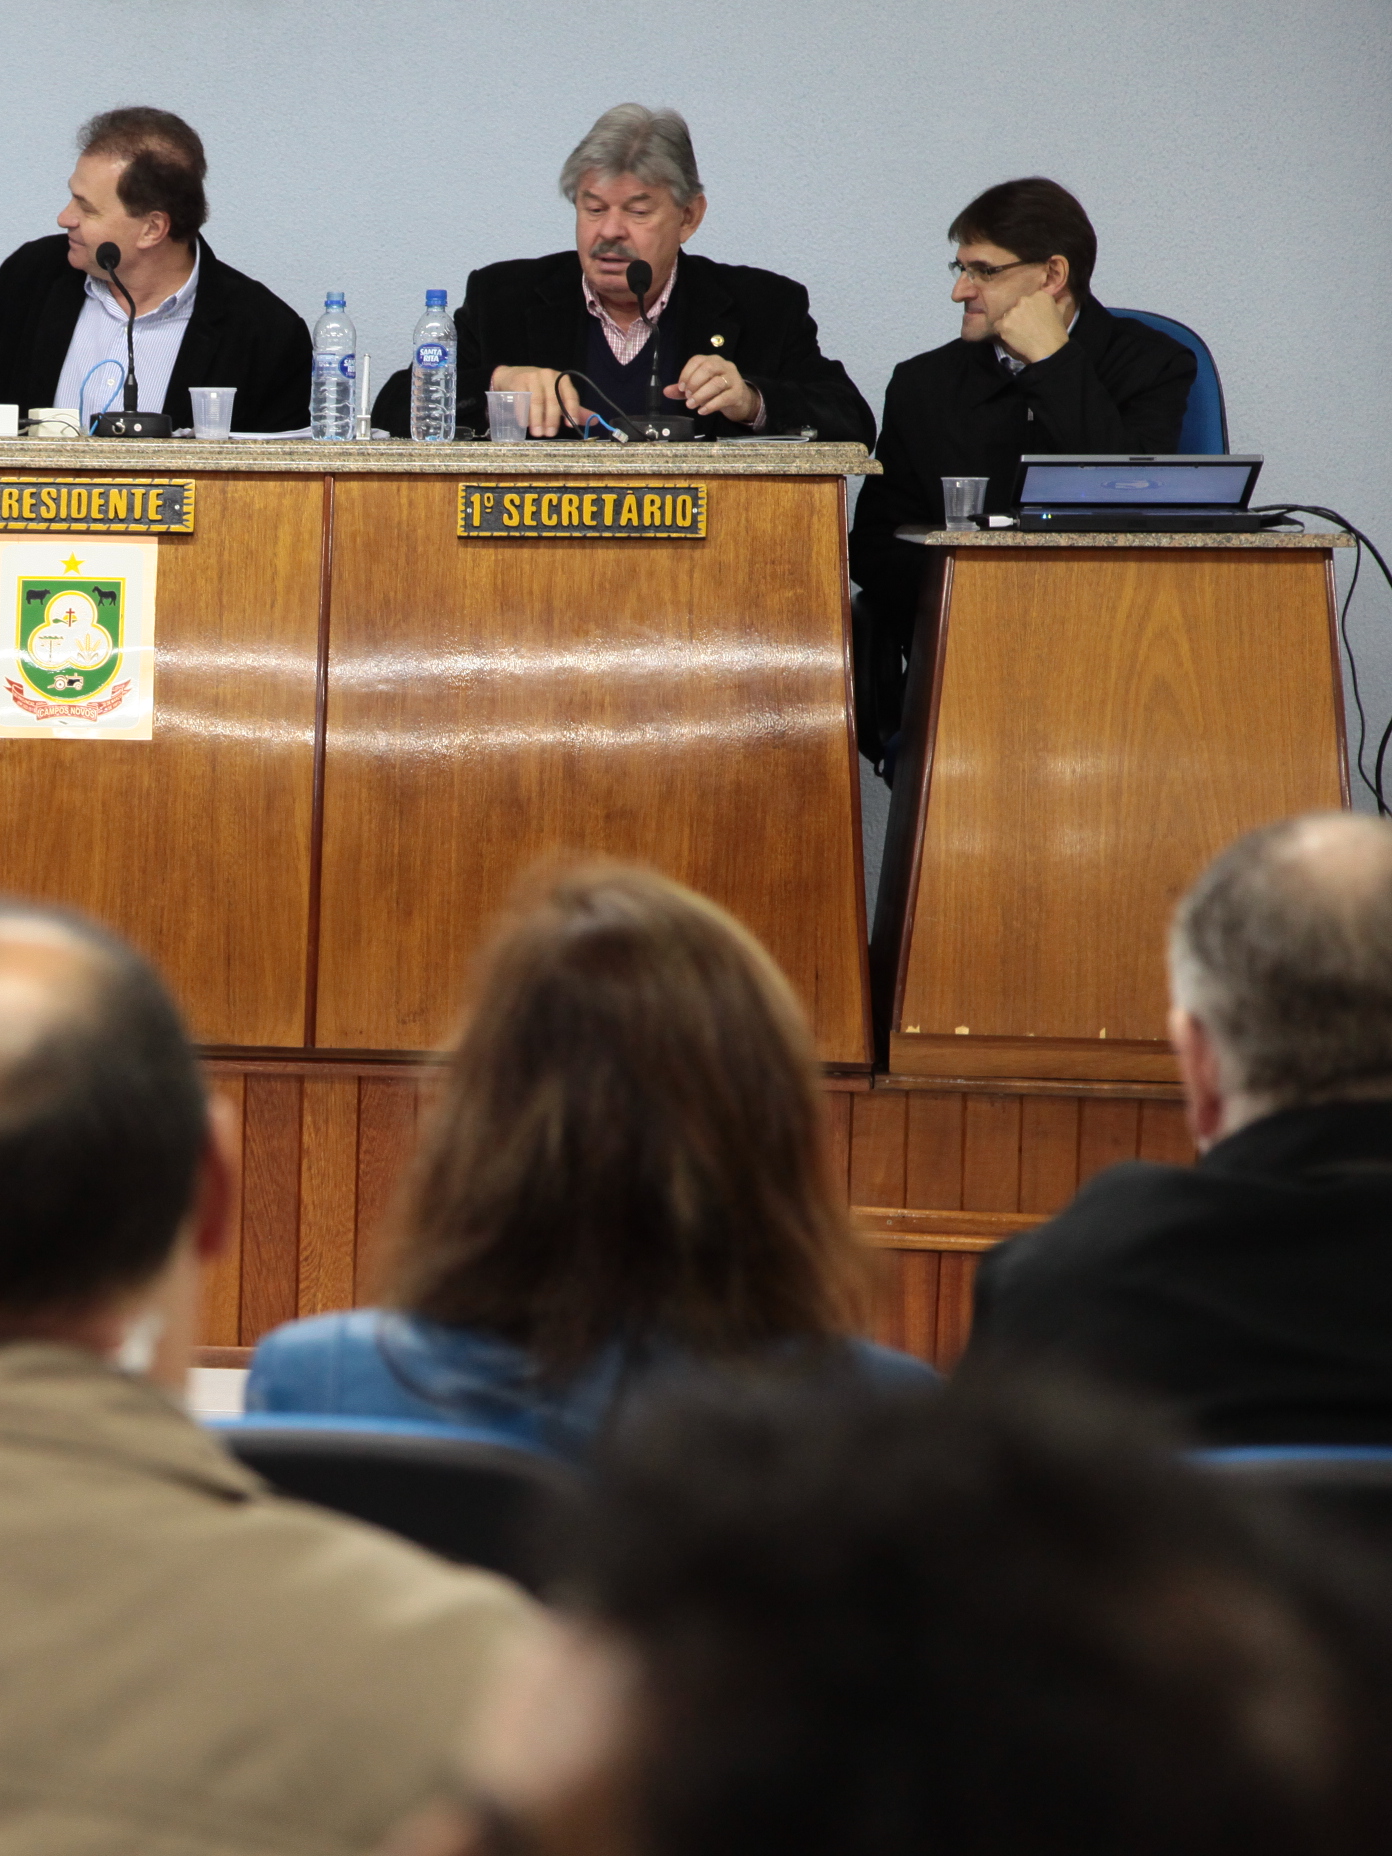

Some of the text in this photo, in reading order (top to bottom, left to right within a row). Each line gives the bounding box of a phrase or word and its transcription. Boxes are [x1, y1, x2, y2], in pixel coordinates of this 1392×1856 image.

[420, 348, 442, 356] SANTA
[502, 490, 693, 528] SECRETÁRIO
[39, 705, 95, 718] CAMPOS NOVOS
